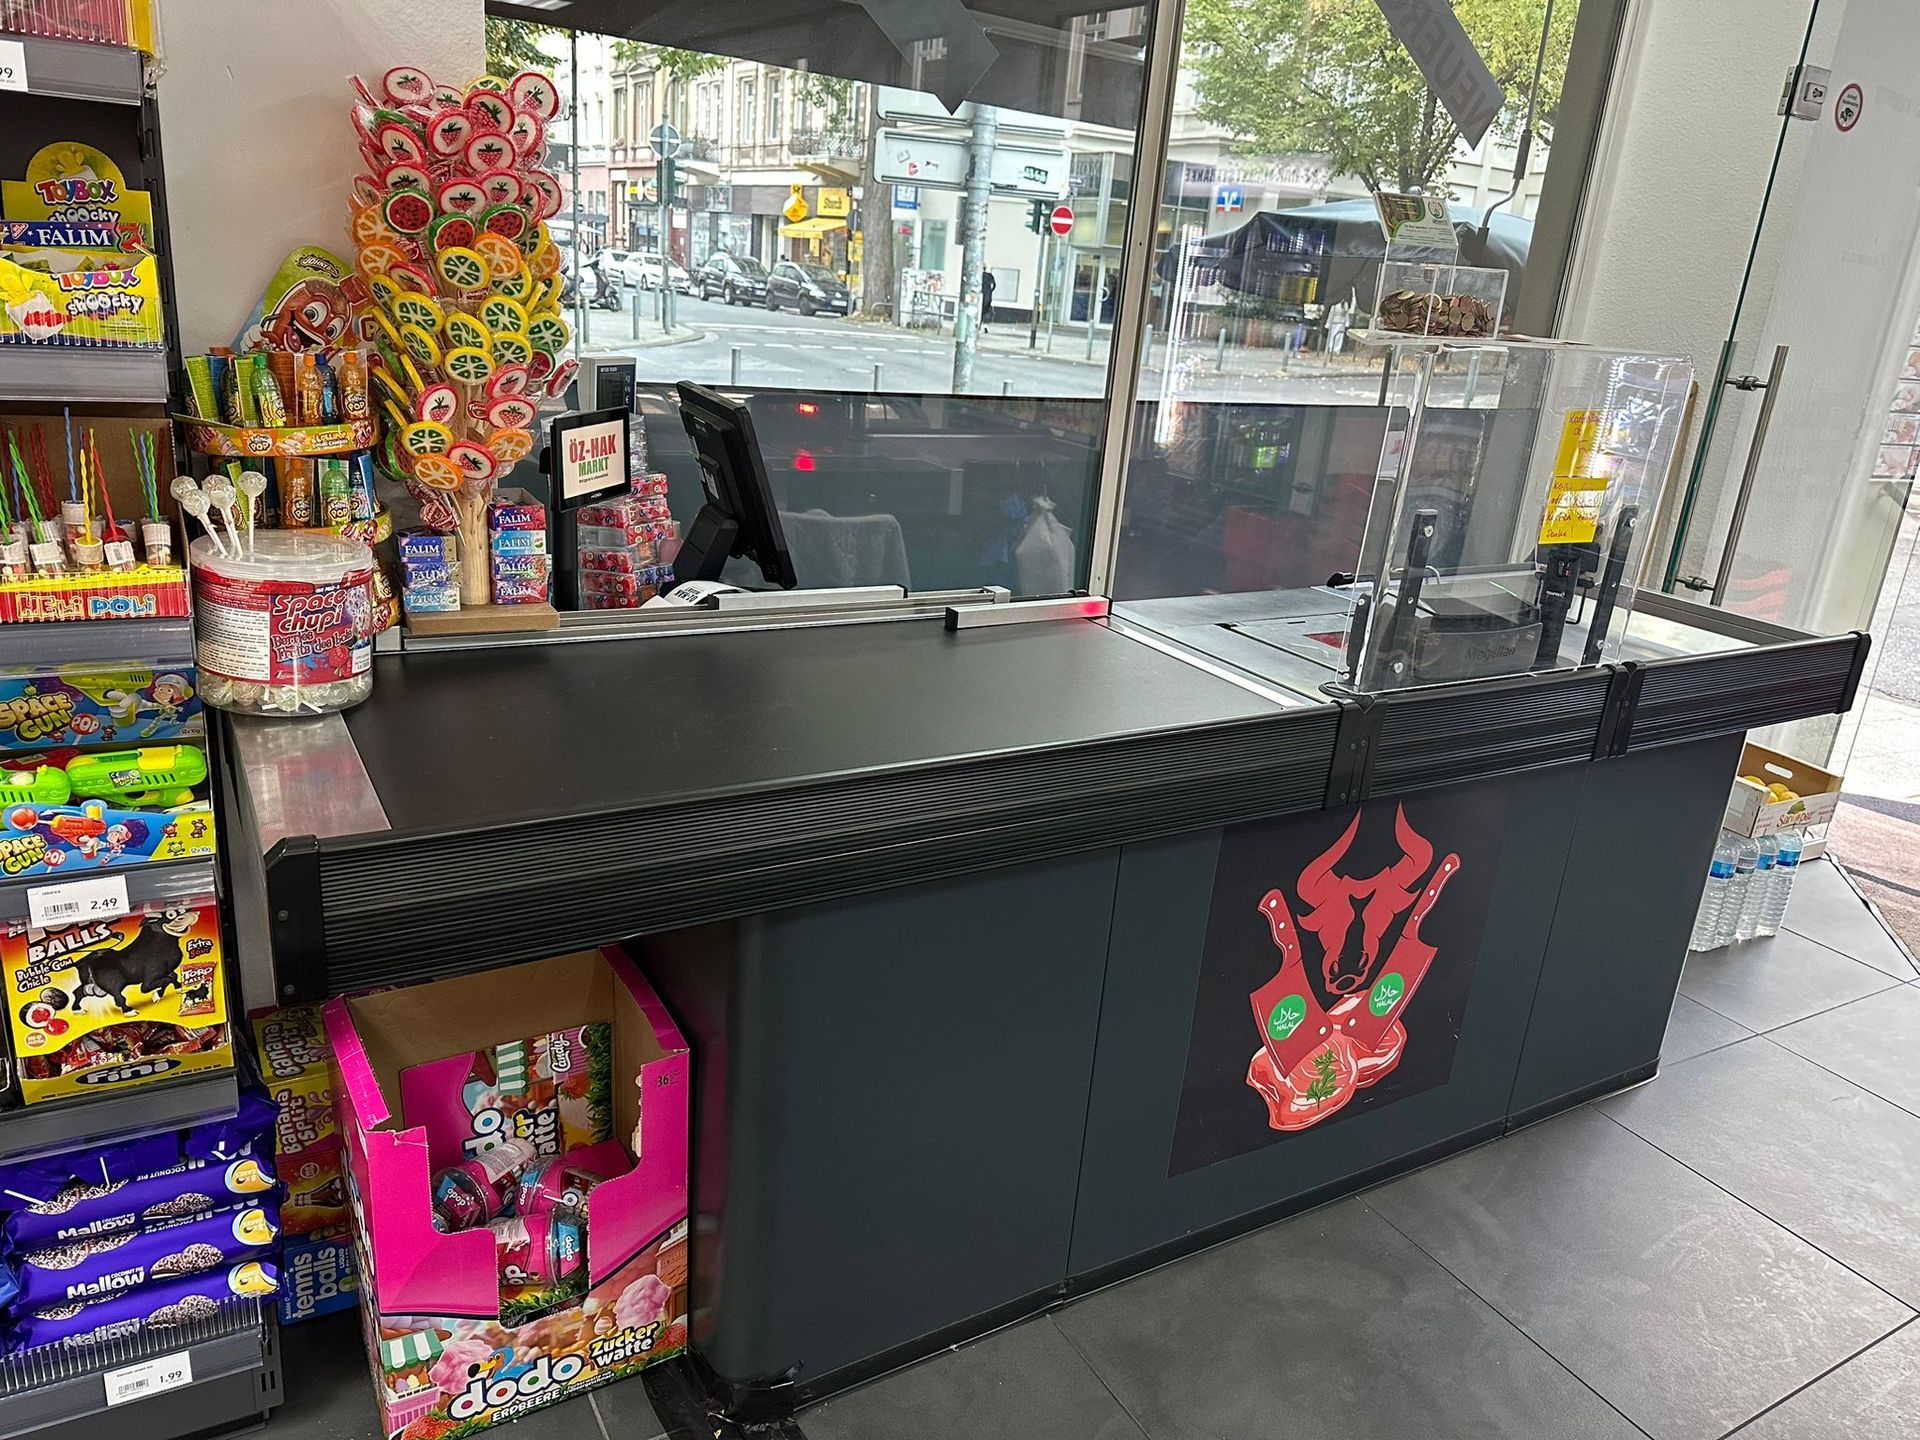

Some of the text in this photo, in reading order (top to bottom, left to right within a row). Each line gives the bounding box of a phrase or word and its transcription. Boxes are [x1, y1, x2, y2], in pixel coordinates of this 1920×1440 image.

[36, 228, 112, 247] FALIM
[249, 441, 272, 454] POP
[569, 434, 616, 464] ÖZ-HAK
[578, 457, 609, 477] MARKT
[499, 514, 531, 524] FALIM
[405, 544, 439, 554] FALIM
[499, 537, 531, 547] FALIM
[412, 570, 447, 580] FALIM
[499, 563, 532, 572] FALIM
[501, 586, 532, 596] FALIM
[273, 590, 347, 618] Space
[280, 604, 343, 633] chupi
[272, 631, 315, 648] Berries
[315, 638, 332, 652] des
[1465, 645, 1516, 663] Magellan
[0, 693, 73, 727] SPACE
[19, 711, 72, 739] GUN
[71, 715, 99, 732] POP
[0, 834, 45, 858] PACE
[5, 847, 44, 872] GUN
[44, 850, 66, 865] POP
[91, 897, 118, 911] 2.49
[29, 923, 112, 964] BALLS
[187, 939, 214, 952] Extra
[189, 948, 212, 960] Sour
[16, 965, 50, 983] Bubble
[183, 966, 213, 981] TORO
[18, 975, 50, 993] Chicle
[1374, 985, 1399, 1002] حلال
[1376, 999, 1394, 1008] HALAL
[1274, 1007, 1299, 1025] حلال
[1276, 1023, 1295, 1032] HALAL
[550, 1033, 571, 1073] Candy
[657, 1073, 669, 1087] 36
[539, 1111, 557, 1155] atte
[137, 1164, 186, 1182] COCONUT PIE
[447, 1187, 466, 1206] dodo
[57, 1215, 136, 1240] Mallow
[565, 1234, 573, 1262] dodo
[111, 1267, 135, 1279] COCONUT
[313, 1247, 337, 1302] balls
[66, 1270, 145, 1300] Mallow
[289, 1252, 315, 1319] tennis
[63, 1322, 141, 1351] Mallow
[591, 1323, 659, 1357] Zucker
[596, 1337, 652, 1368] watte
[159, 1370, 183, 1384] 1.99
[449, 1355, 583, 1420] dodo
[492, 1389, 561, 1421] ERDBEERE
